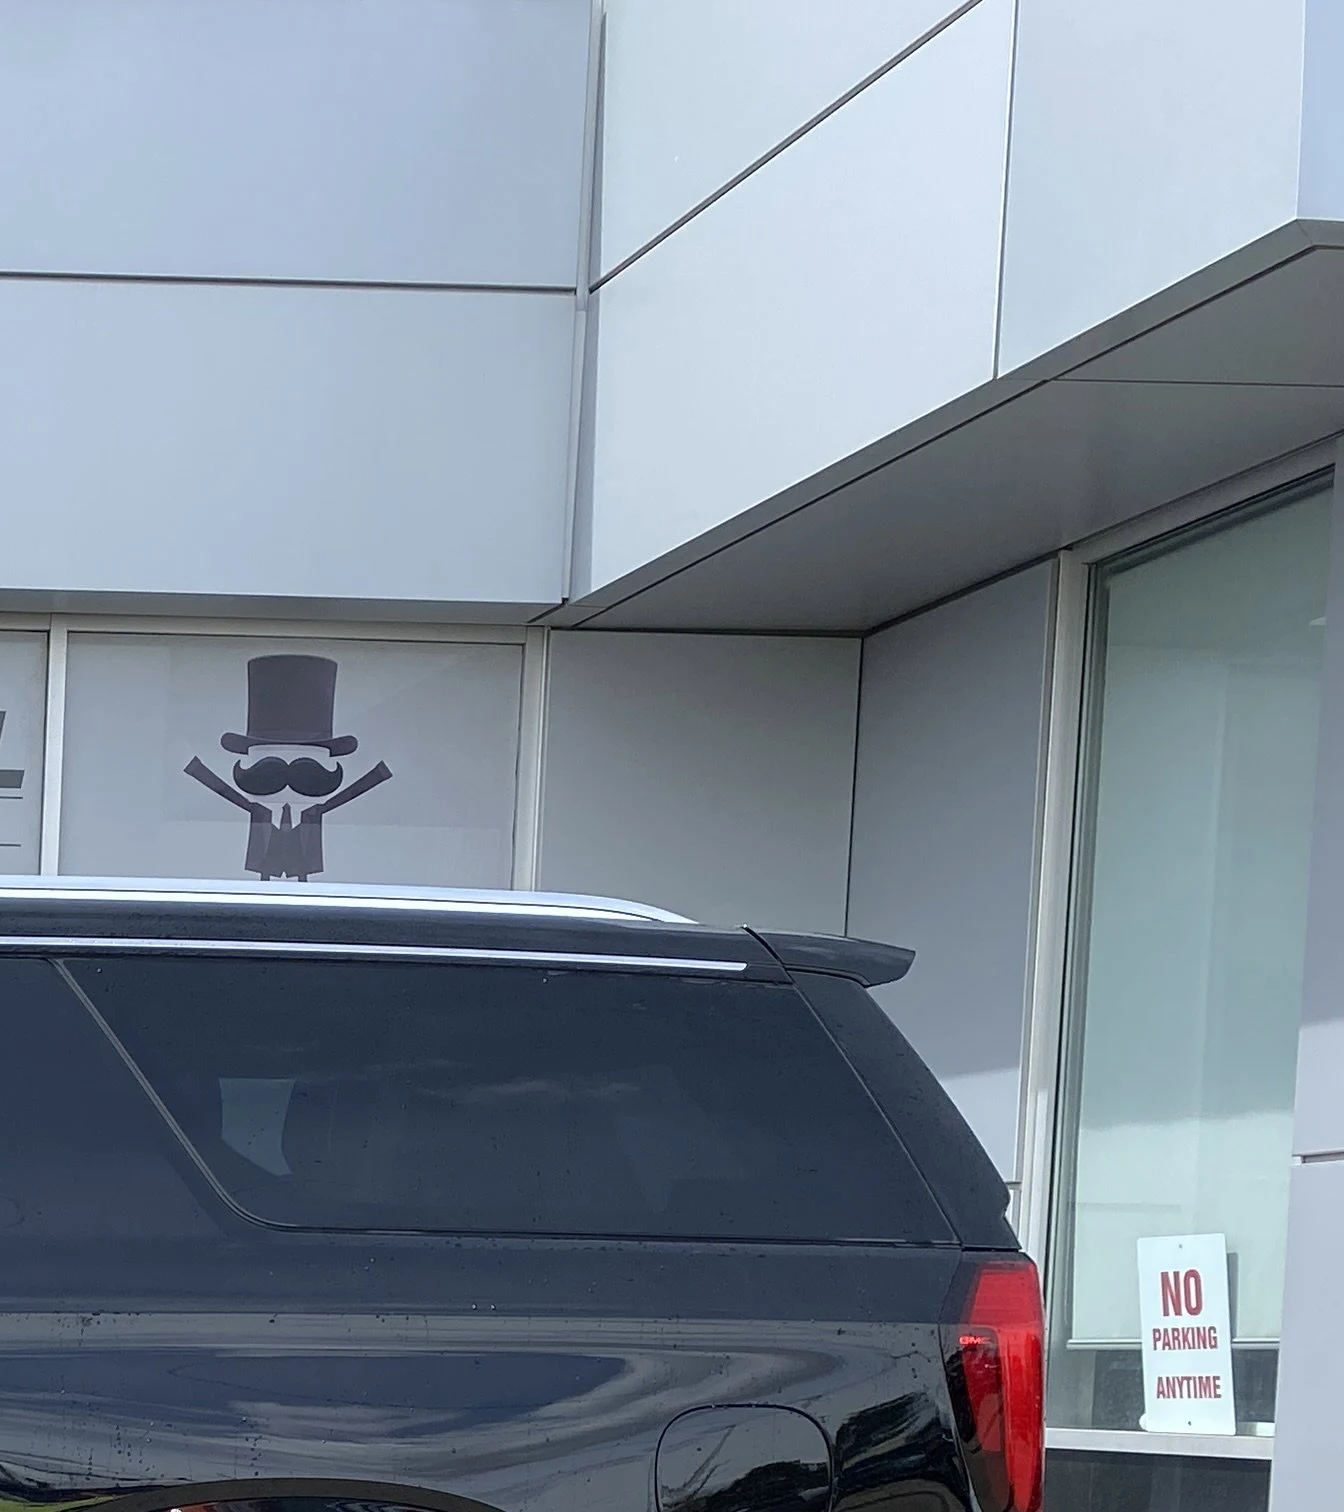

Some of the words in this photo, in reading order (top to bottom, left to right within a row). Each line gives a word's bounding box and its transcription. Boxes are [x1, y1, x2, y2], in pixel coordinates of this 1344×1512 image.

[1160, 1268, 1203, 1318] NO
[1152, 1325, 1219, 1351] PARKING
[1155, 1375, 1222, 1400] ANYTIME
